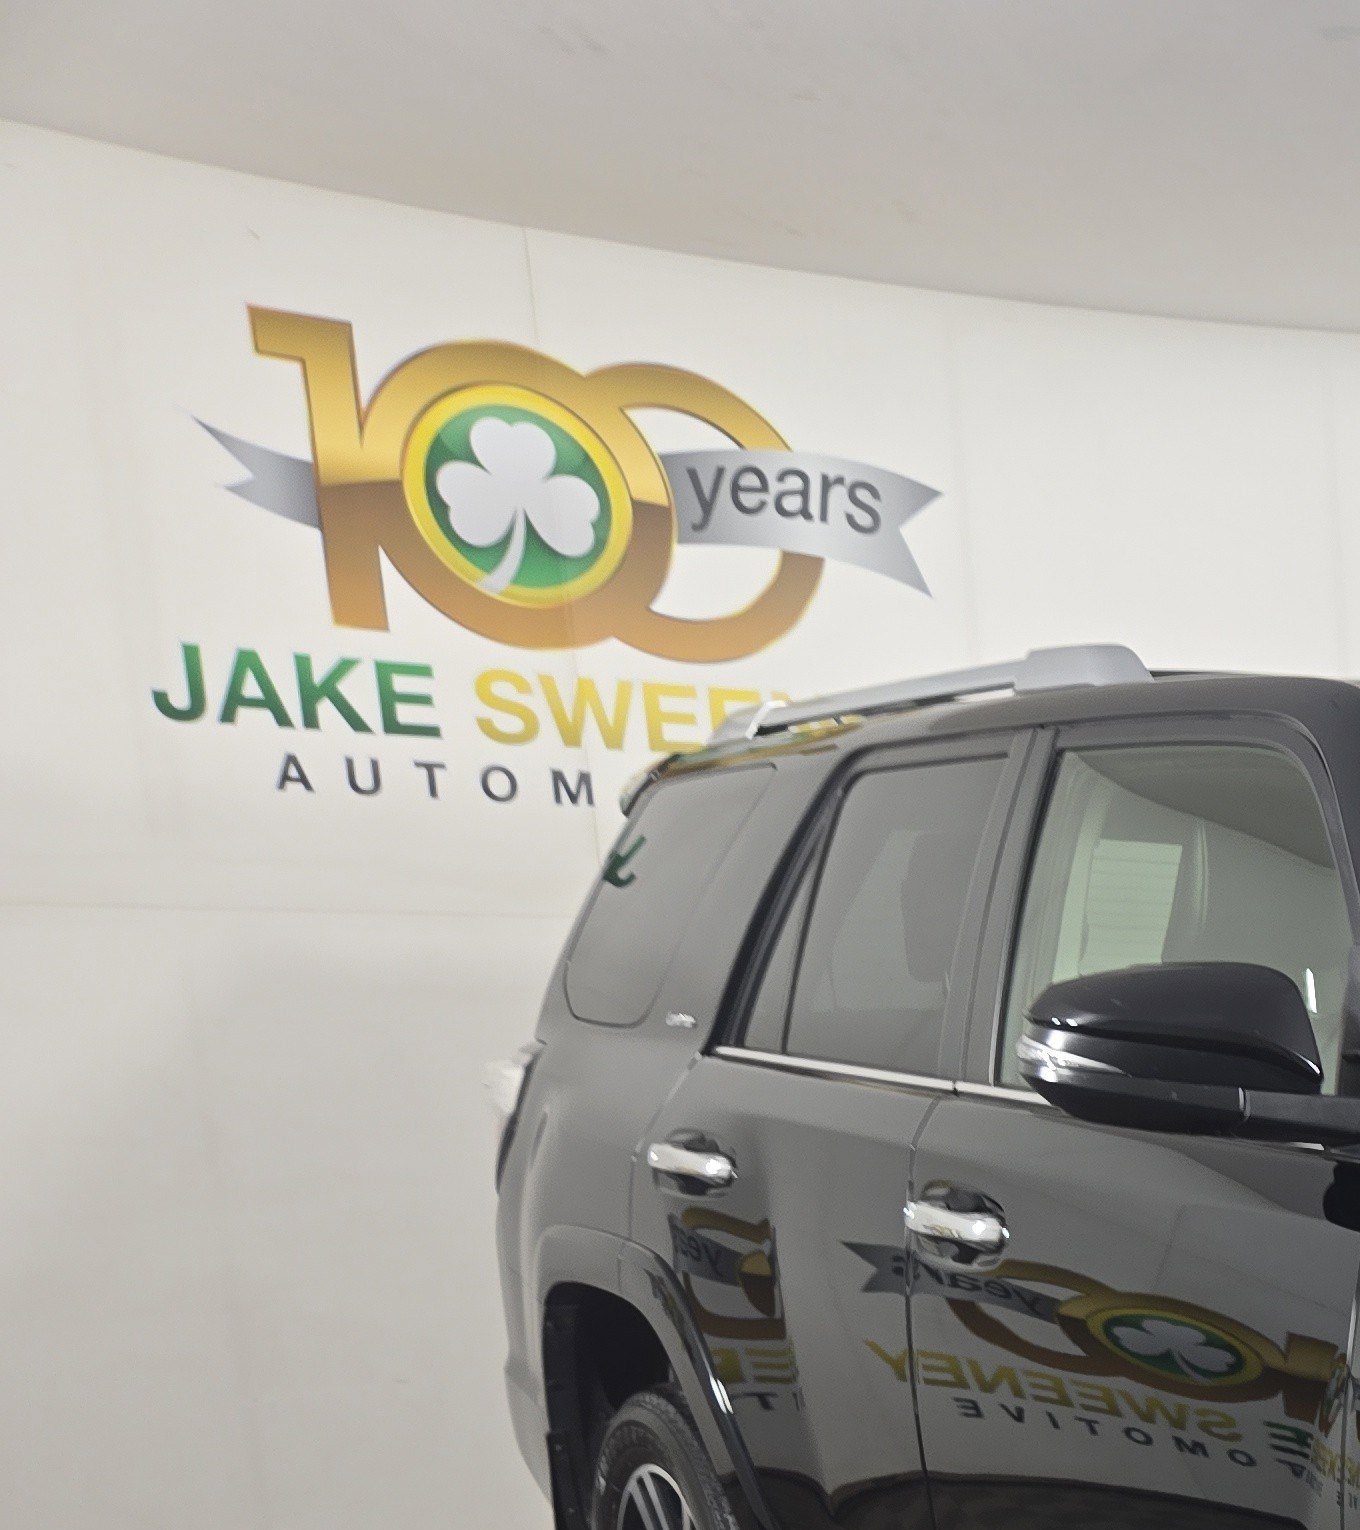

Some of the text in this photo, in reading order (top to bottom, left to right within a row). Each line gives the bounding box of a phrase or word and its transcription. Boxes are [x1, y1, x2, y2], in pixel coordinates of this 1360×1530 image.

[246, 303, 882, 664] 100 years
[153, 642, 790, 757] JAKE SWEE
[275, 753, 595, 806] AUTOM
